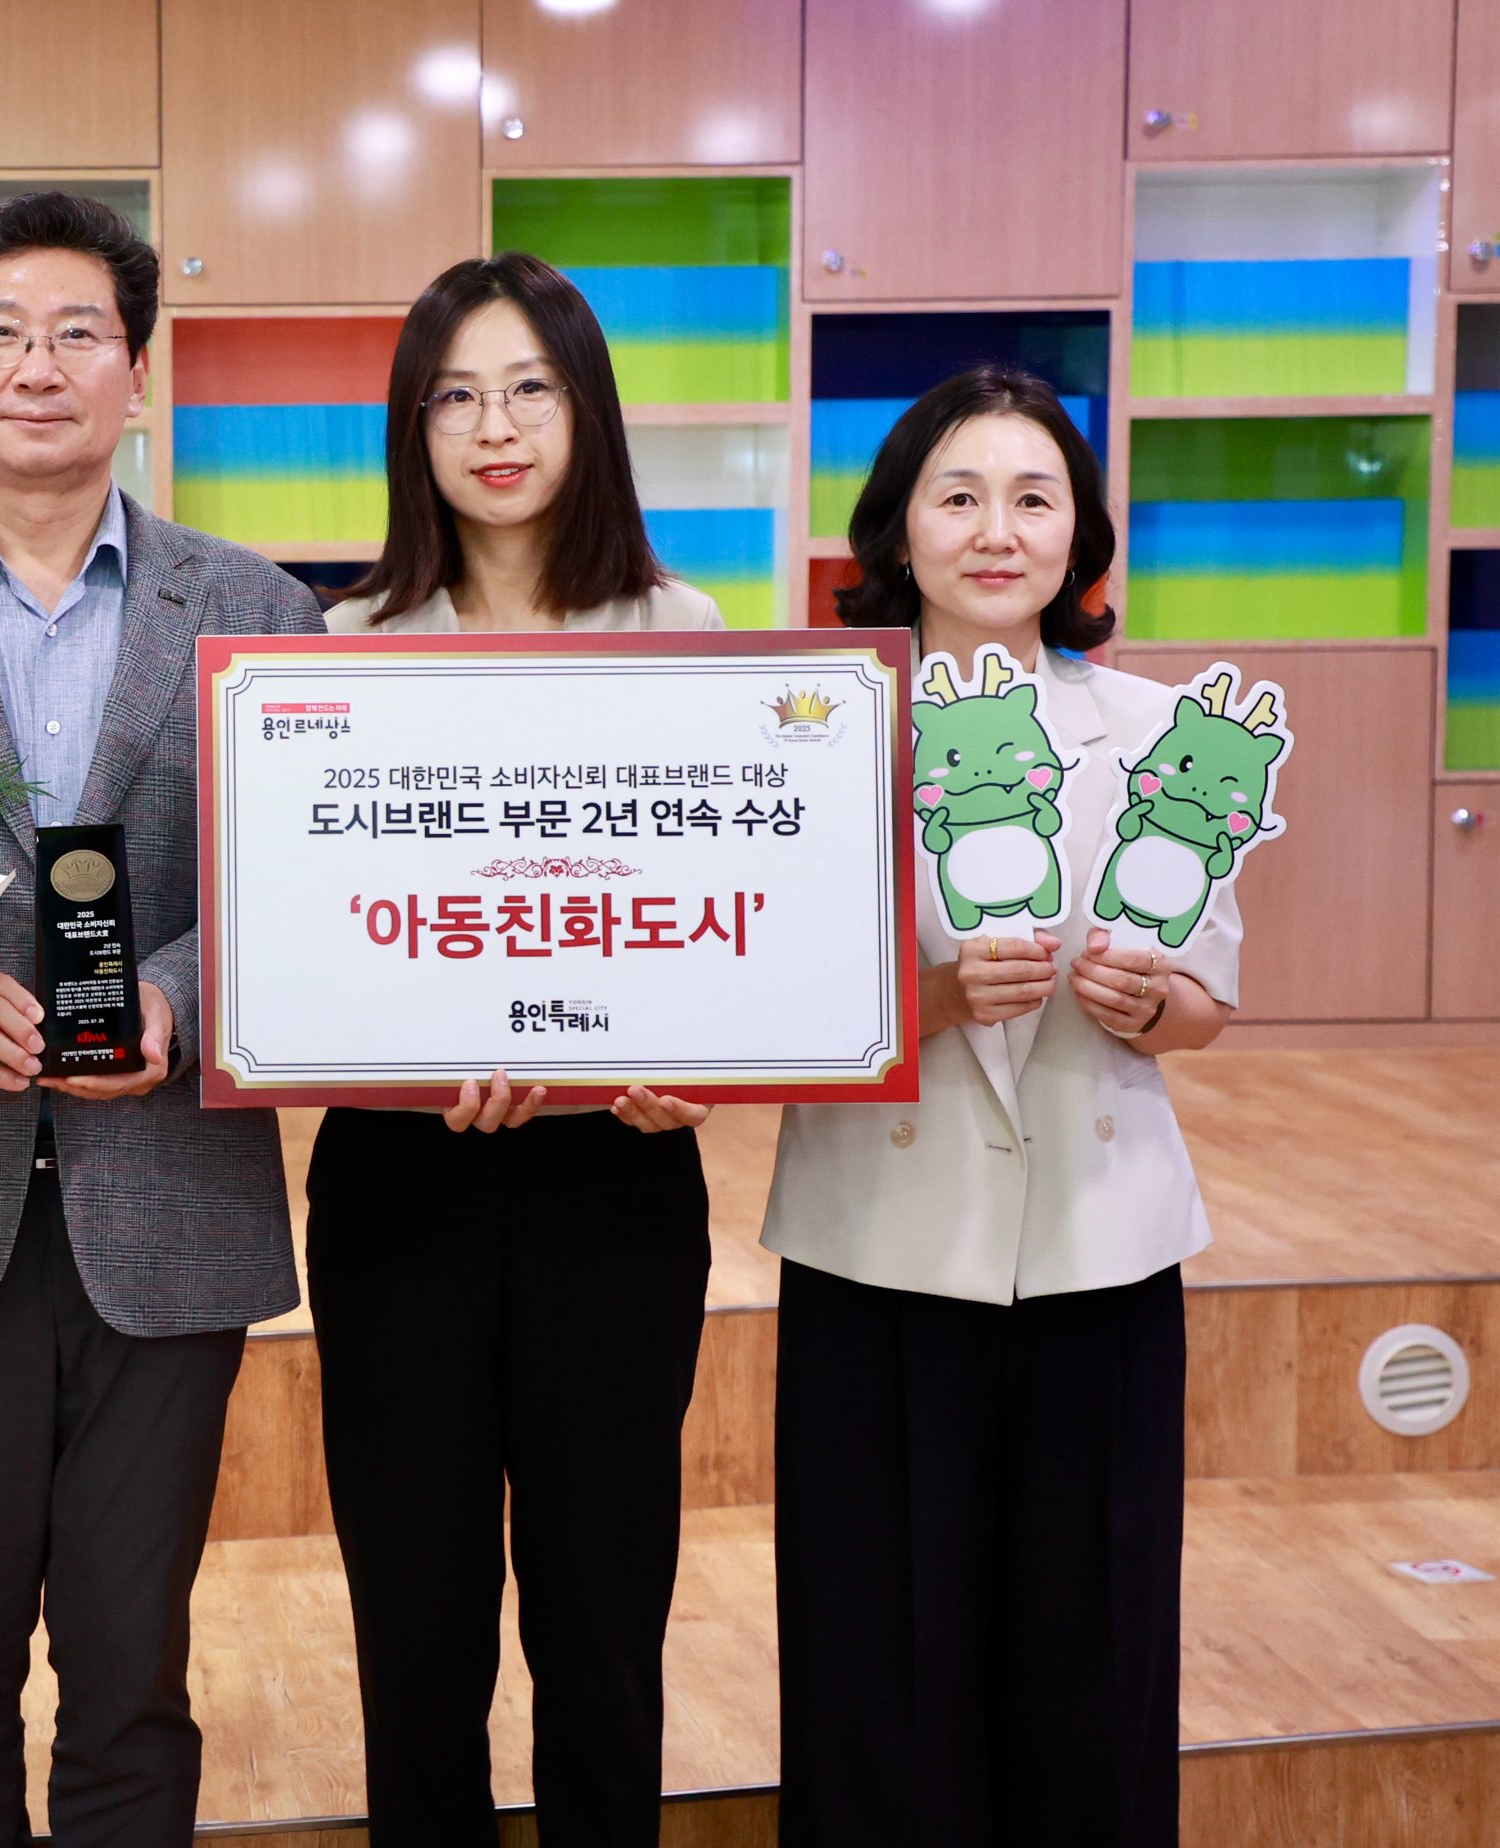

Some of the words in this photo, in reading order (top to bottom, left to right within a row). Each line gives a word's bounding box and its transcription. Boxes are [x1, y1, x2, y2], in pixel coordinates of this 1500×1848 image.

[294, 717, 351, 739] 르네상스
[324, 769, 380, 788] 2025
[390, 766, 482, 790] 대한민국
[490, 765, 607, 789] 소비자신뢰
[617, 764, 734, 788] 대표브랜드
[742, 763, 789, 788] 대상
[308, 800, 489, 839] 도시브랜드
[499, 800, 572, 839] 부문
[582, 799, 638, 837] 2년
[651, 798, 723, 837] 연속
[732, 798, 805, 837] 수상
[508, 1000, 609, 1033] 용인특례시
